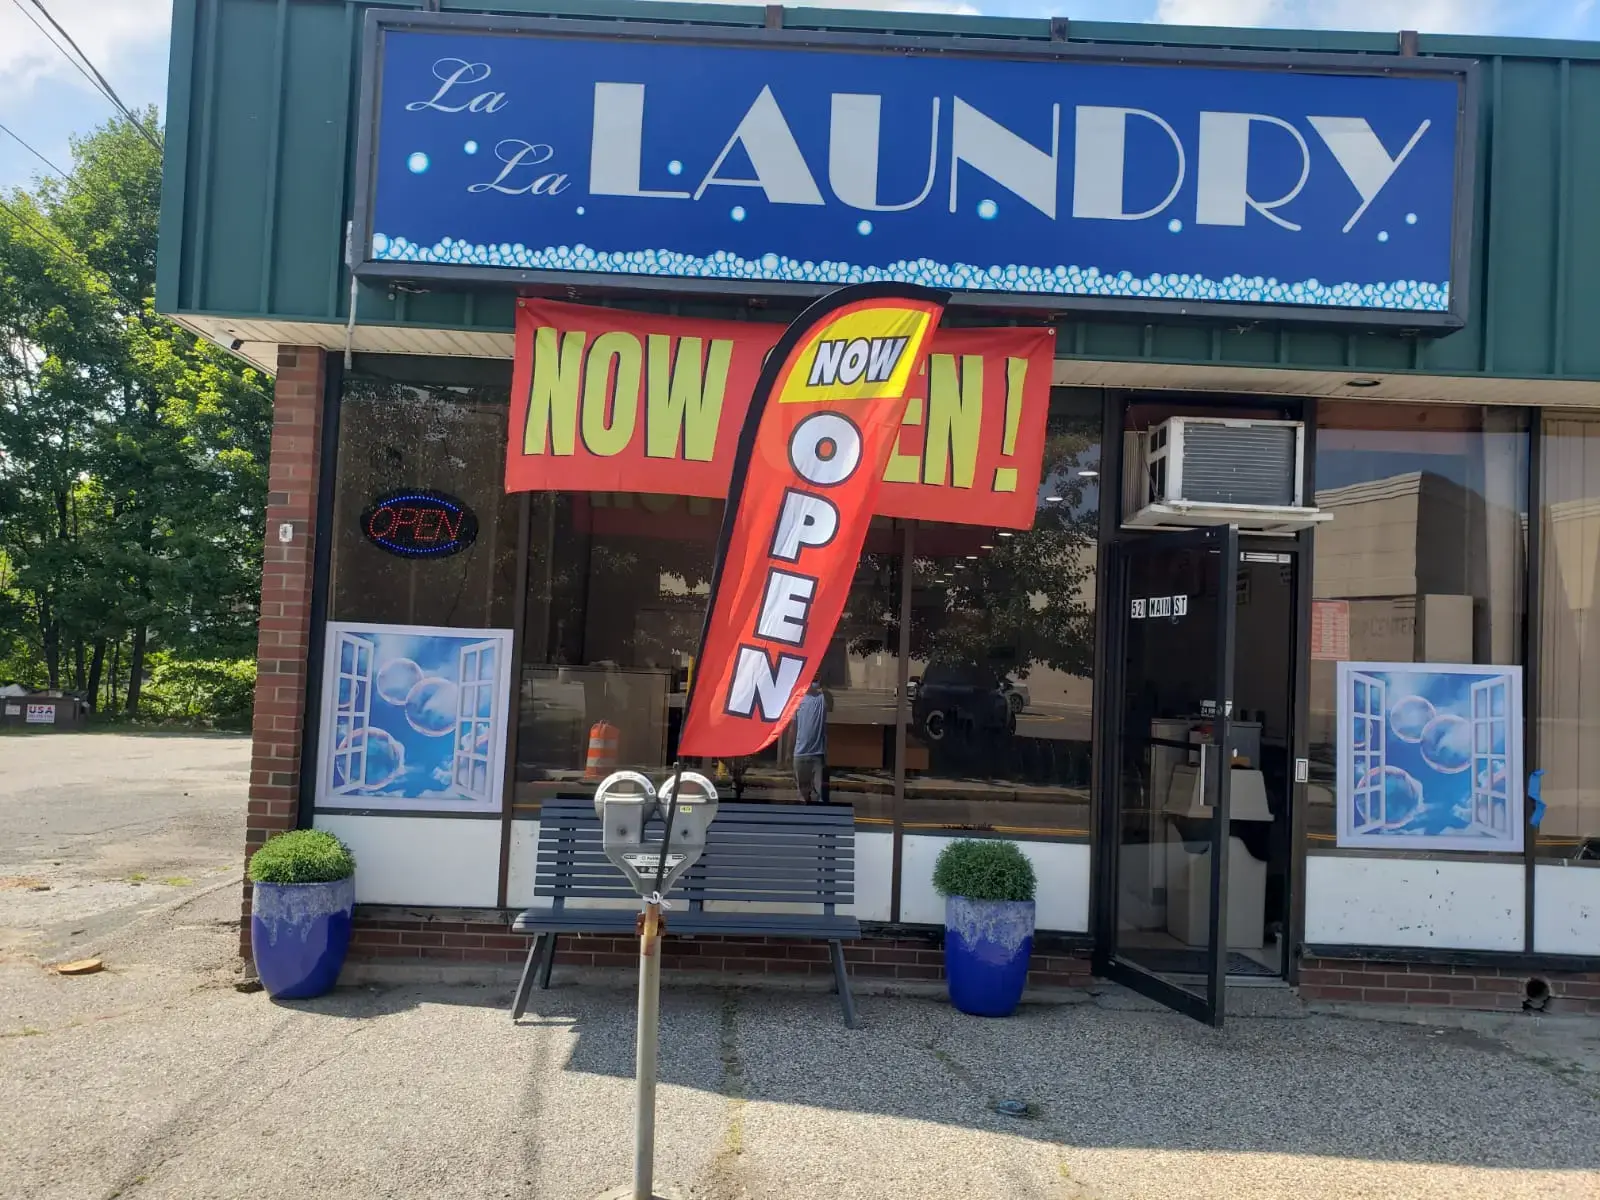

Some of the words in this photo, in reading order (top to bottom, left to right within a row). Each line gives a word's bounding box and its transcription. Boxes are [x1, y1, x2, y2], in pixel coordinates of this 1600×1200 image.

[405, 58, 508, 113] La
[467, 139, 571, 195] La
[589, 82, 1431, 233] LAUNDRY
[806, 336, 909, 387] NOW
[524, 327, 734, 461] NOW
[369, 507, 463, 540] OPEN
[724, 411, 864, 722] OPEN
[1149, 597, 1170, 616] MAIN
[1174, 596, 1187, 615] ST
[29, 705, 53, 714] USA
